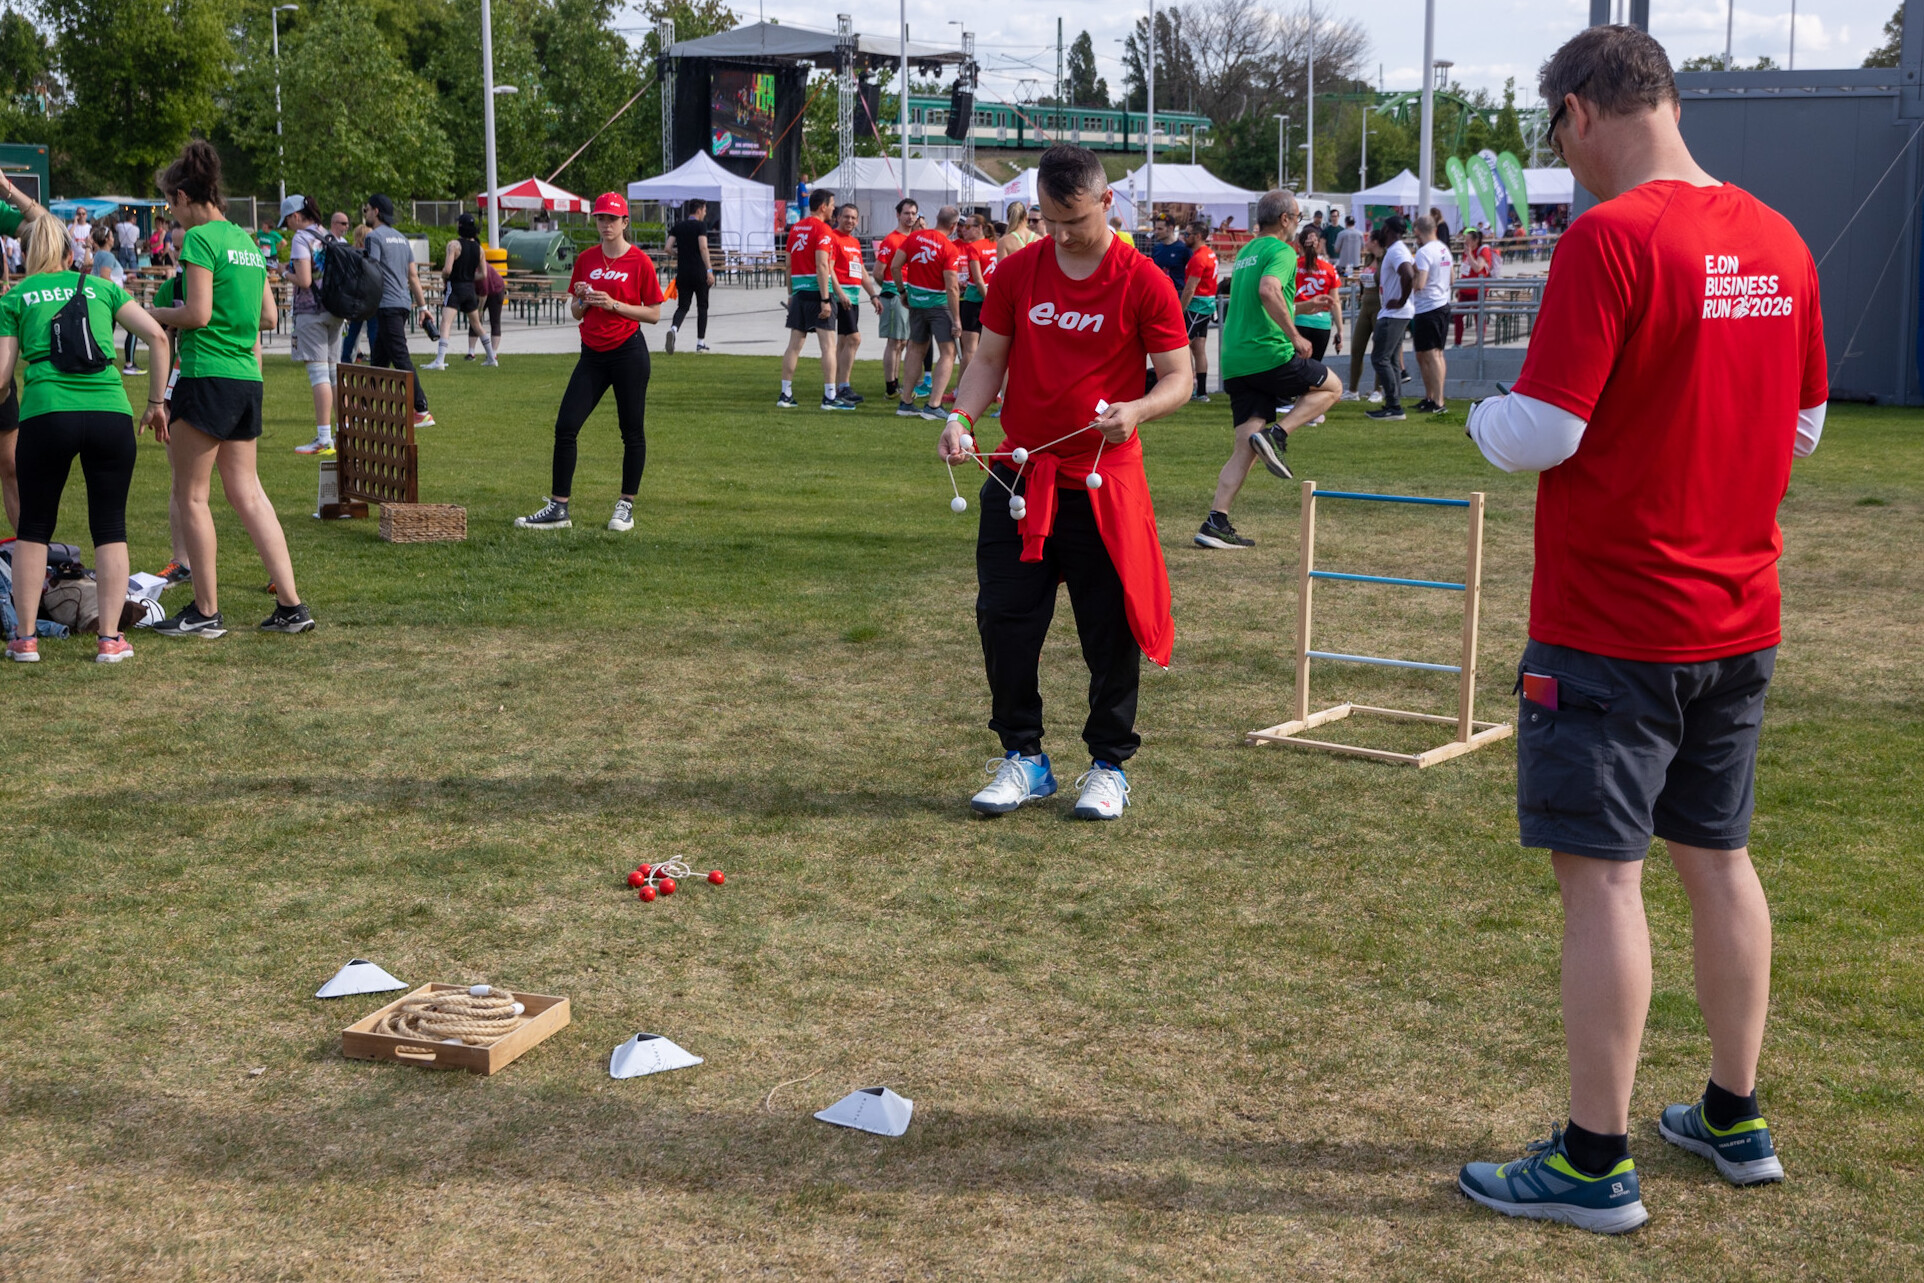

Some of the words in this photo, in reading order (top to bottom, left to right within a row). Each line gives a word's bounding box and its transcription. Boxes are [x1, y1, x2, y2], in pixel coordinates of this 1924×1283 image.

[1704, 254, 1740, 275] E.ON
[40, 286, 97, 302] BÉRS
[1704, 274, 1780, 297] BUSINESS
[1701, 298, 1732, 320] RUN
[1749, 296, 1793, 317] 2026
